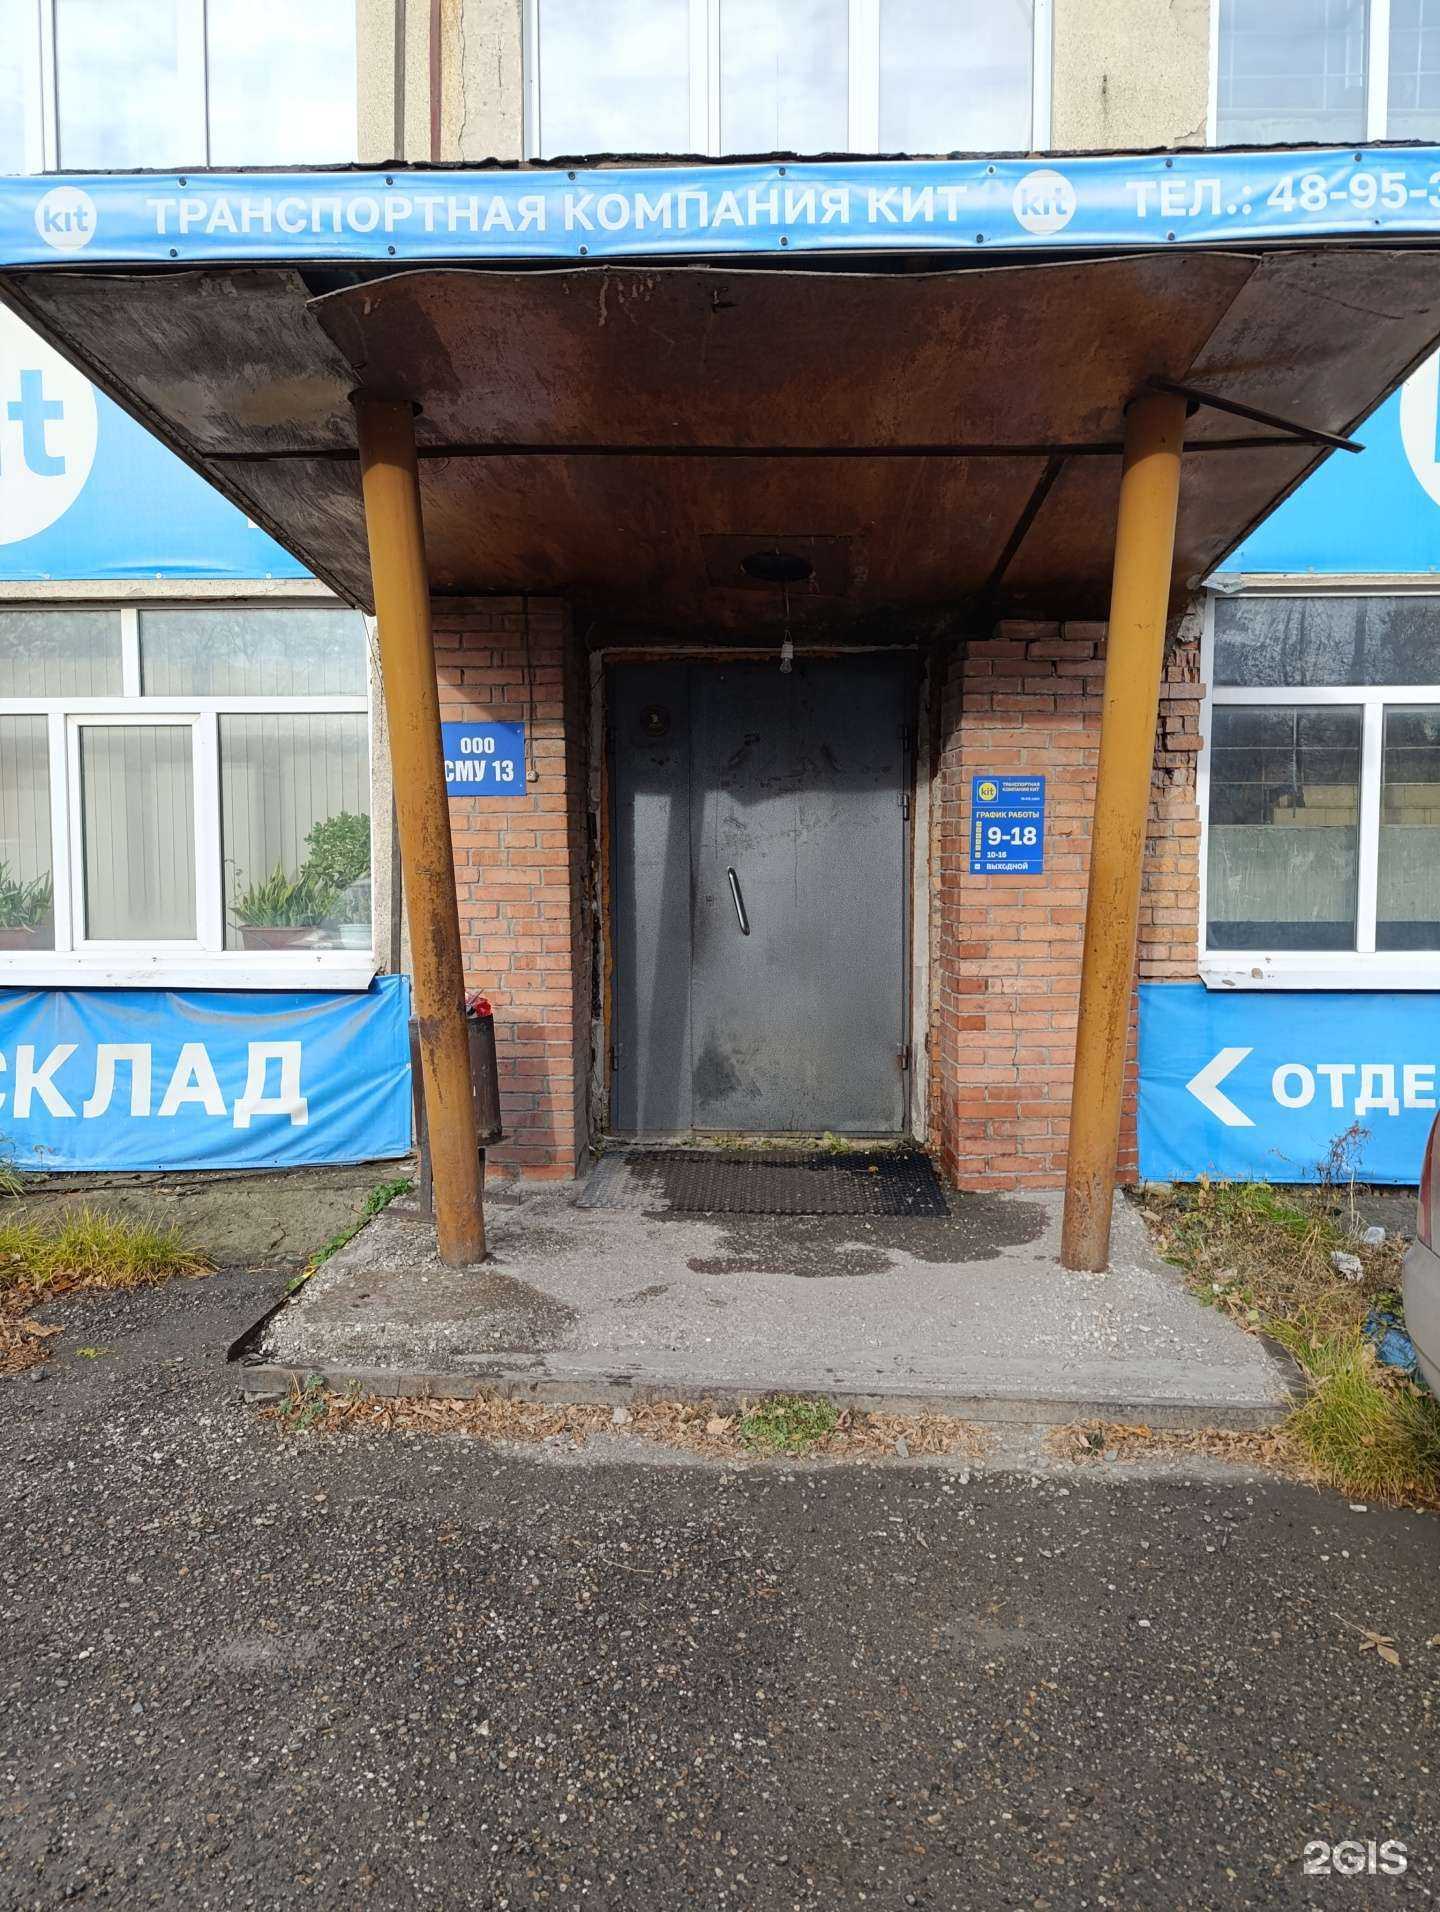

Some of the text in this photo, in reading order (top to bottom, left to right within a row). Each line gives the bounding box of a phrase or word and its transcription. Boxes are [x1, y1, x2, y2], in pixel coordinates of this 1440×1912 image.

[146, 185, 968, 235] ТРАНСПОРТНАЯ КОМПАНИЯ КИТ
[1020, 187, 1069, 217] kit
[1126, 178, 1253, 217] ТЕЛ.:
[43, 205, 89, 233] kit
[460, 736, 495, 754] ООО
[444, 759, 514, 782] СМУ 13
[976, 811, 1007, 819] ГРАФИК
[987, 826, 1037, 846] 9-18
[986, 862, 1029, 871] ВЫХОДНОЙ
[0, 1041, 309, 1129] КЛАД
[1271, 1063, 1437, 1117] ОТДЕ
